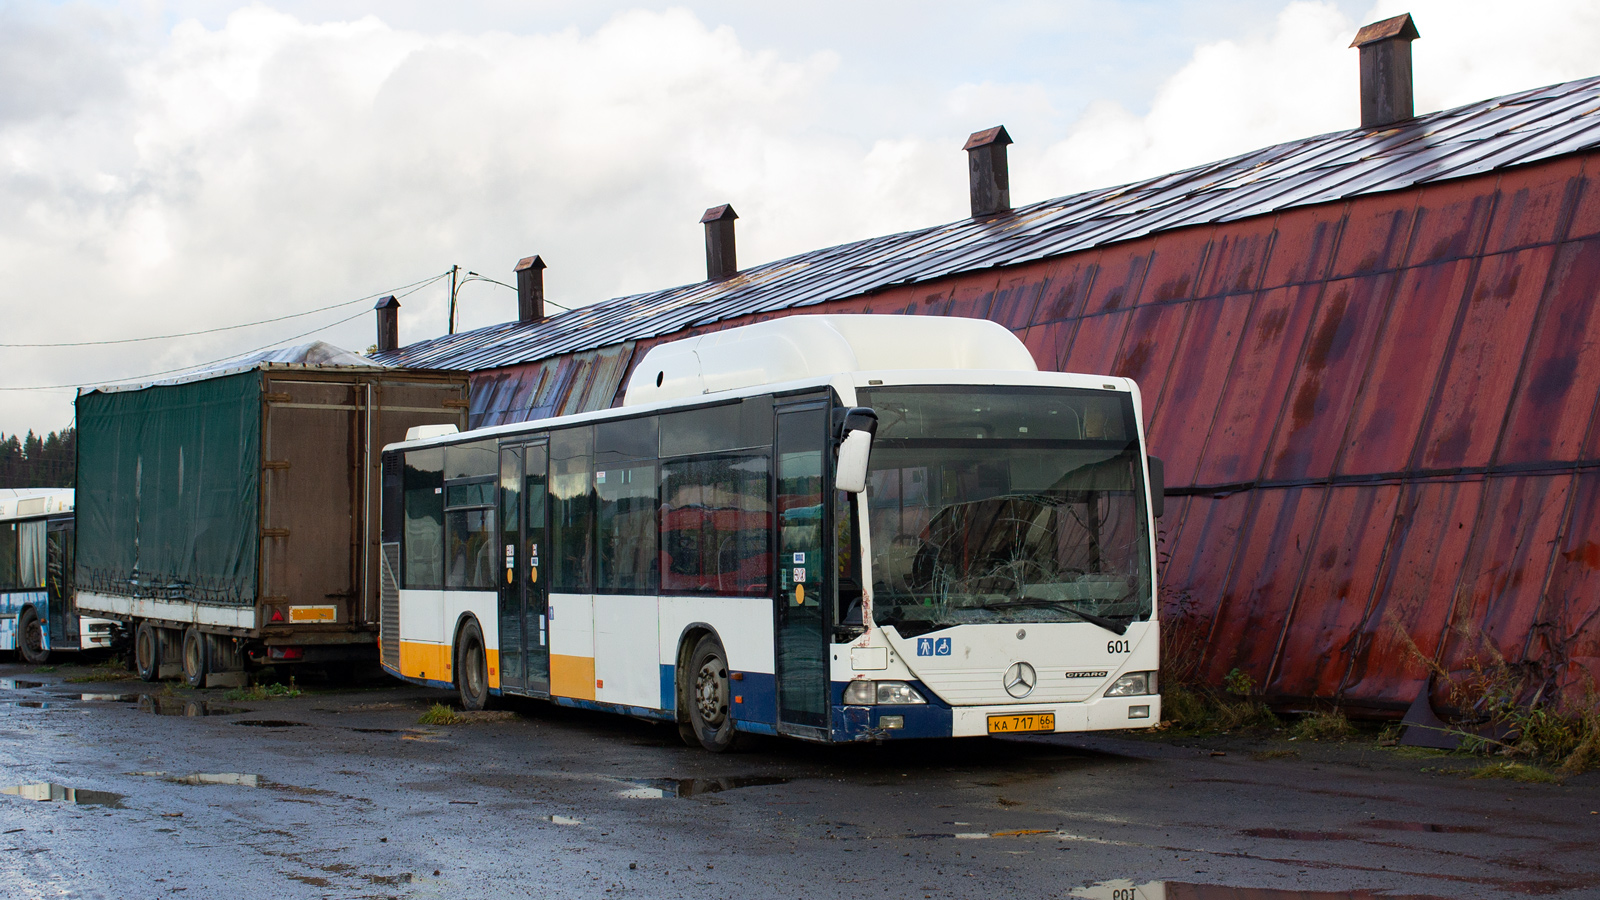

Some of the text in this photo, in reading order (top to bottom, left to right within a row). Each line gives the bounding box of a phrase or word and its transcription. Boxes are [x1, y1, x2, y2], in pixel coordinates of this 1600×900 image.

[1107, 640, 1131, 654] 601
[1013, 717, 1033, 730] 717
[1040, 715, 1051, 725] 66
